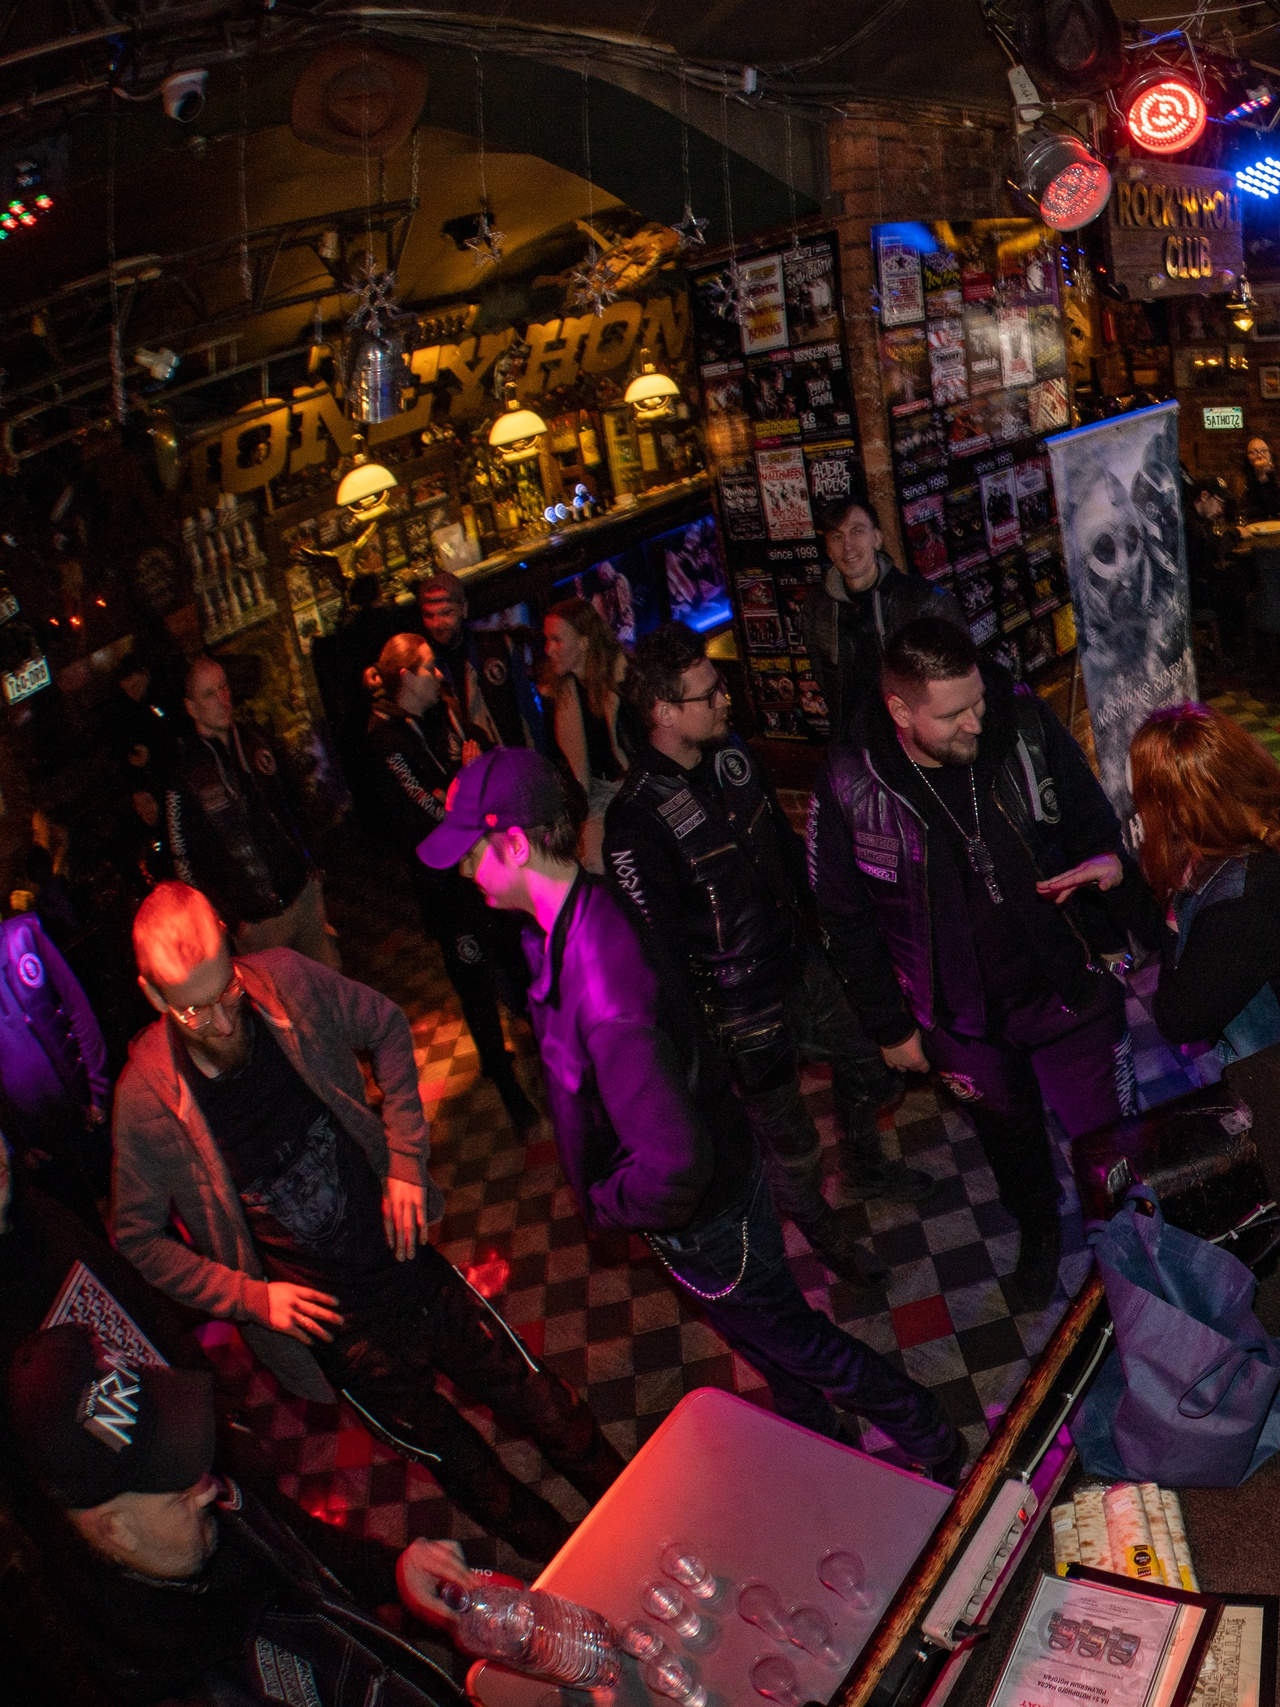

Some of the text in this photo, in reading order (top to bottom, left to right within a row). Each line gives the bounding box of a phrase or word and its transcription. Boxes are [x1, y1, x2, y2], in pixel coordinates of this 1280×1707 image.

[1166, 235, 1213, 280] CLUB
[903, 472, 949, 500] since 1993
[769, 546, 819, 561] since 1993
[1037, 1680, 1057, 1692] МАСЛА
[1043, 1673, 1107, 1696] POLYMERIUM MOTOFAN
[1057, 1686, 1092, 1701] МОТОРНОГО
[1101, 1694, 1110, 1704] НА
